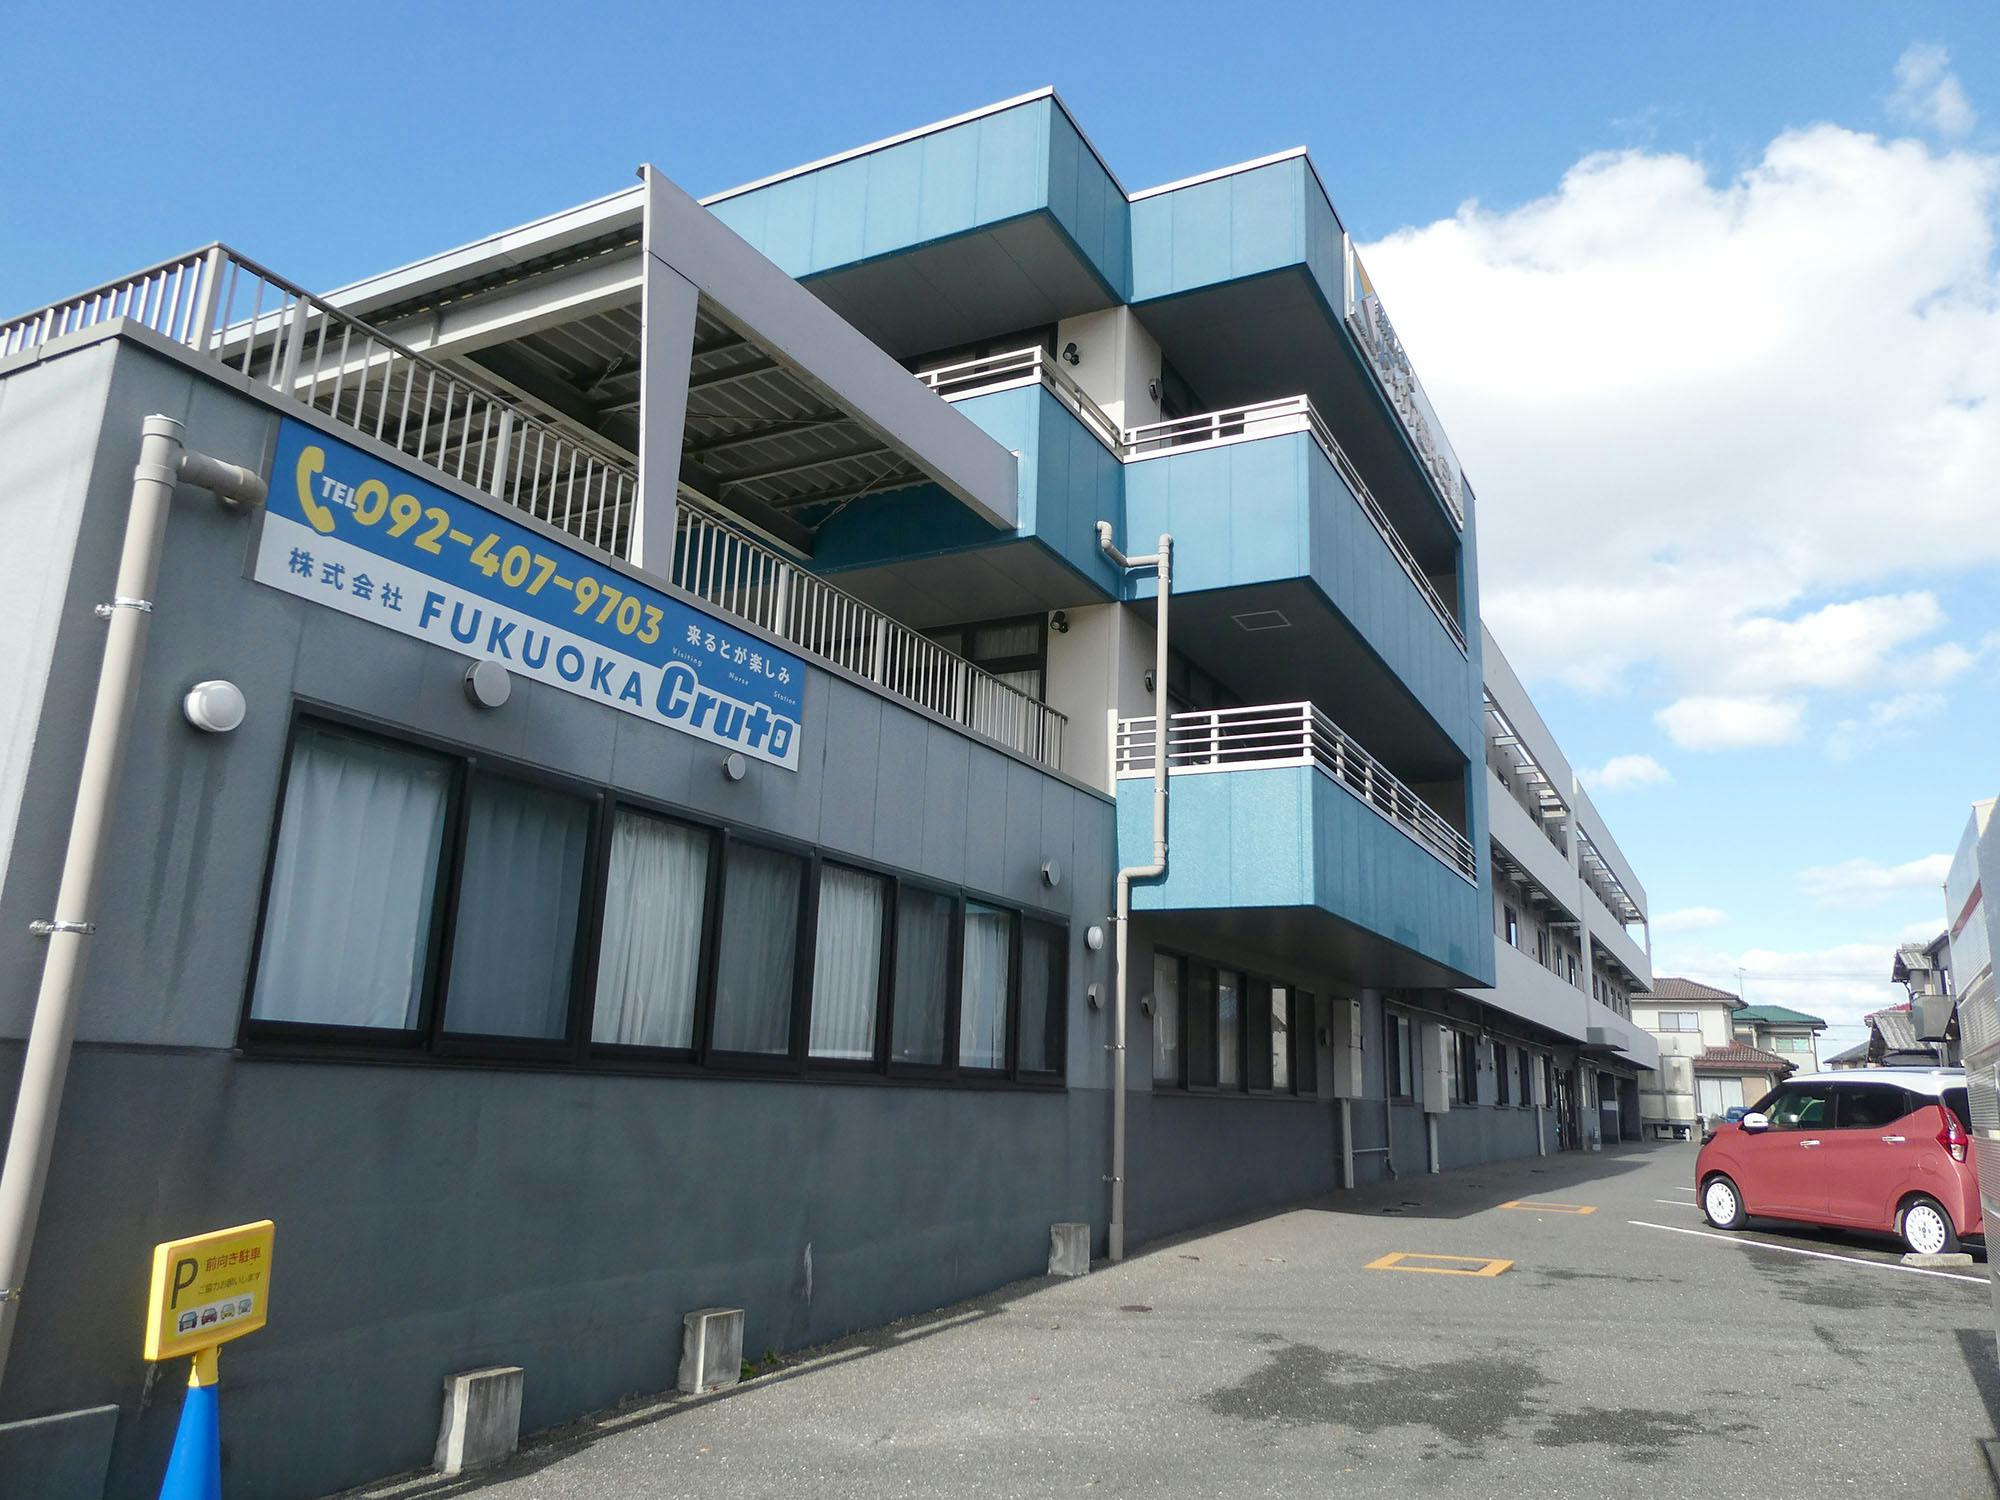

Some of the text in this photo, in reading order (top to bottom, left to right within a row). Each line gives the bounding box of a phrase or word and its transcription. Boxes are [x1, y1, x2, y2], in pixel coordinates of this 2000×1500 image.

[321, 475, 664, 644] TEL 092-407-9703
[289, 547, 793, 758] 株式会社 FUKUOKA Cruto
[672, 647, 703, 667] Visiting
[728, 671, 749, 686] Nurse
[687, 625, 791, 685] 来るとが楽しみ
[171, 1257, 199, 1310] P
[205, 1247, 262, 1271] 前向き駐車
